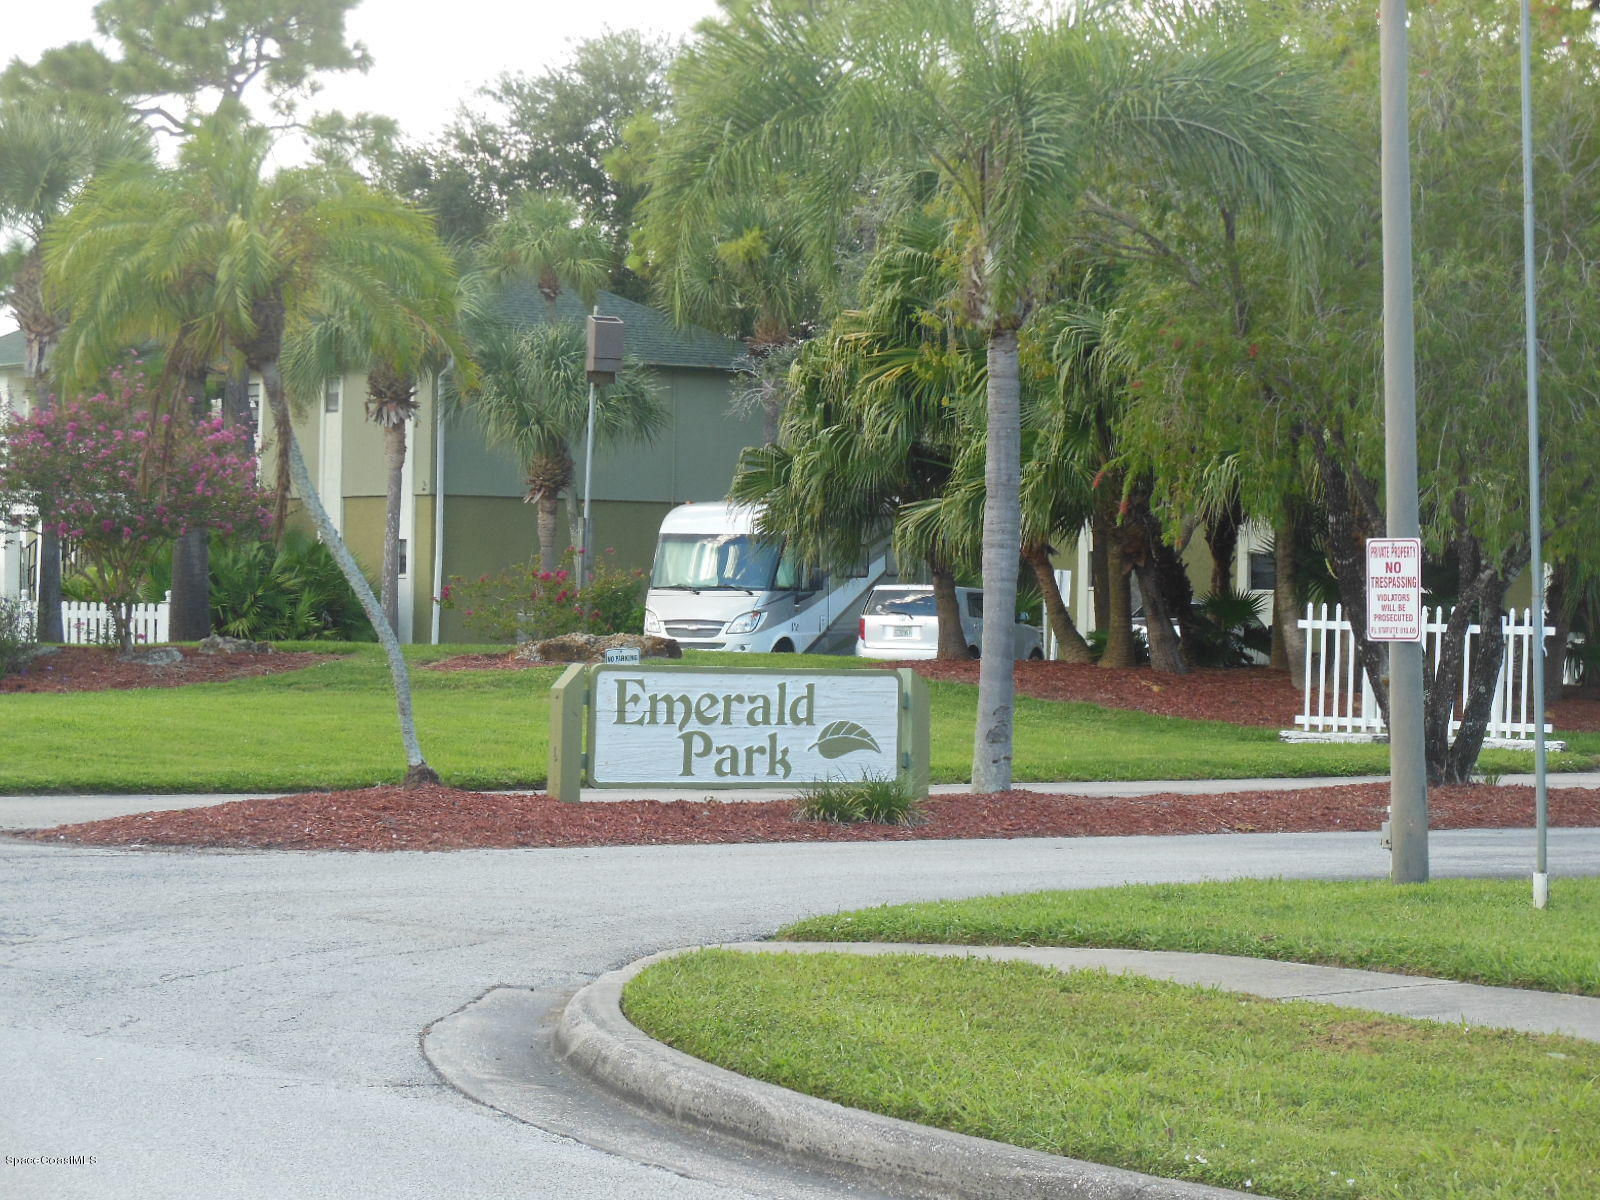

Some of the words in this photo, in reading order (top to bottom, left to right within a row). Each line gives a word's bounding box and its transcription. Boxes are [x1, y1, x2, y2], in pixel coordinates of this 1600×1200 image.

[1370, 546, 1389, 558] PRIVATE
[1391, 546, 1416, 558] PROPERTY
[1385, 561, 1402, 574] NO
[1371, 576, 1417, 588] TRESPASSING
[1377, 593, 1410, 602] VIOLATORS
[1381, 604, 1396, 612] WILL
[1398, 604, 1406, 612] BE
[1374, 613, 1414, 622] PROSECUTED
[613, 679, 816, 731] Emerald
[677, 730, 792, 779] Park
